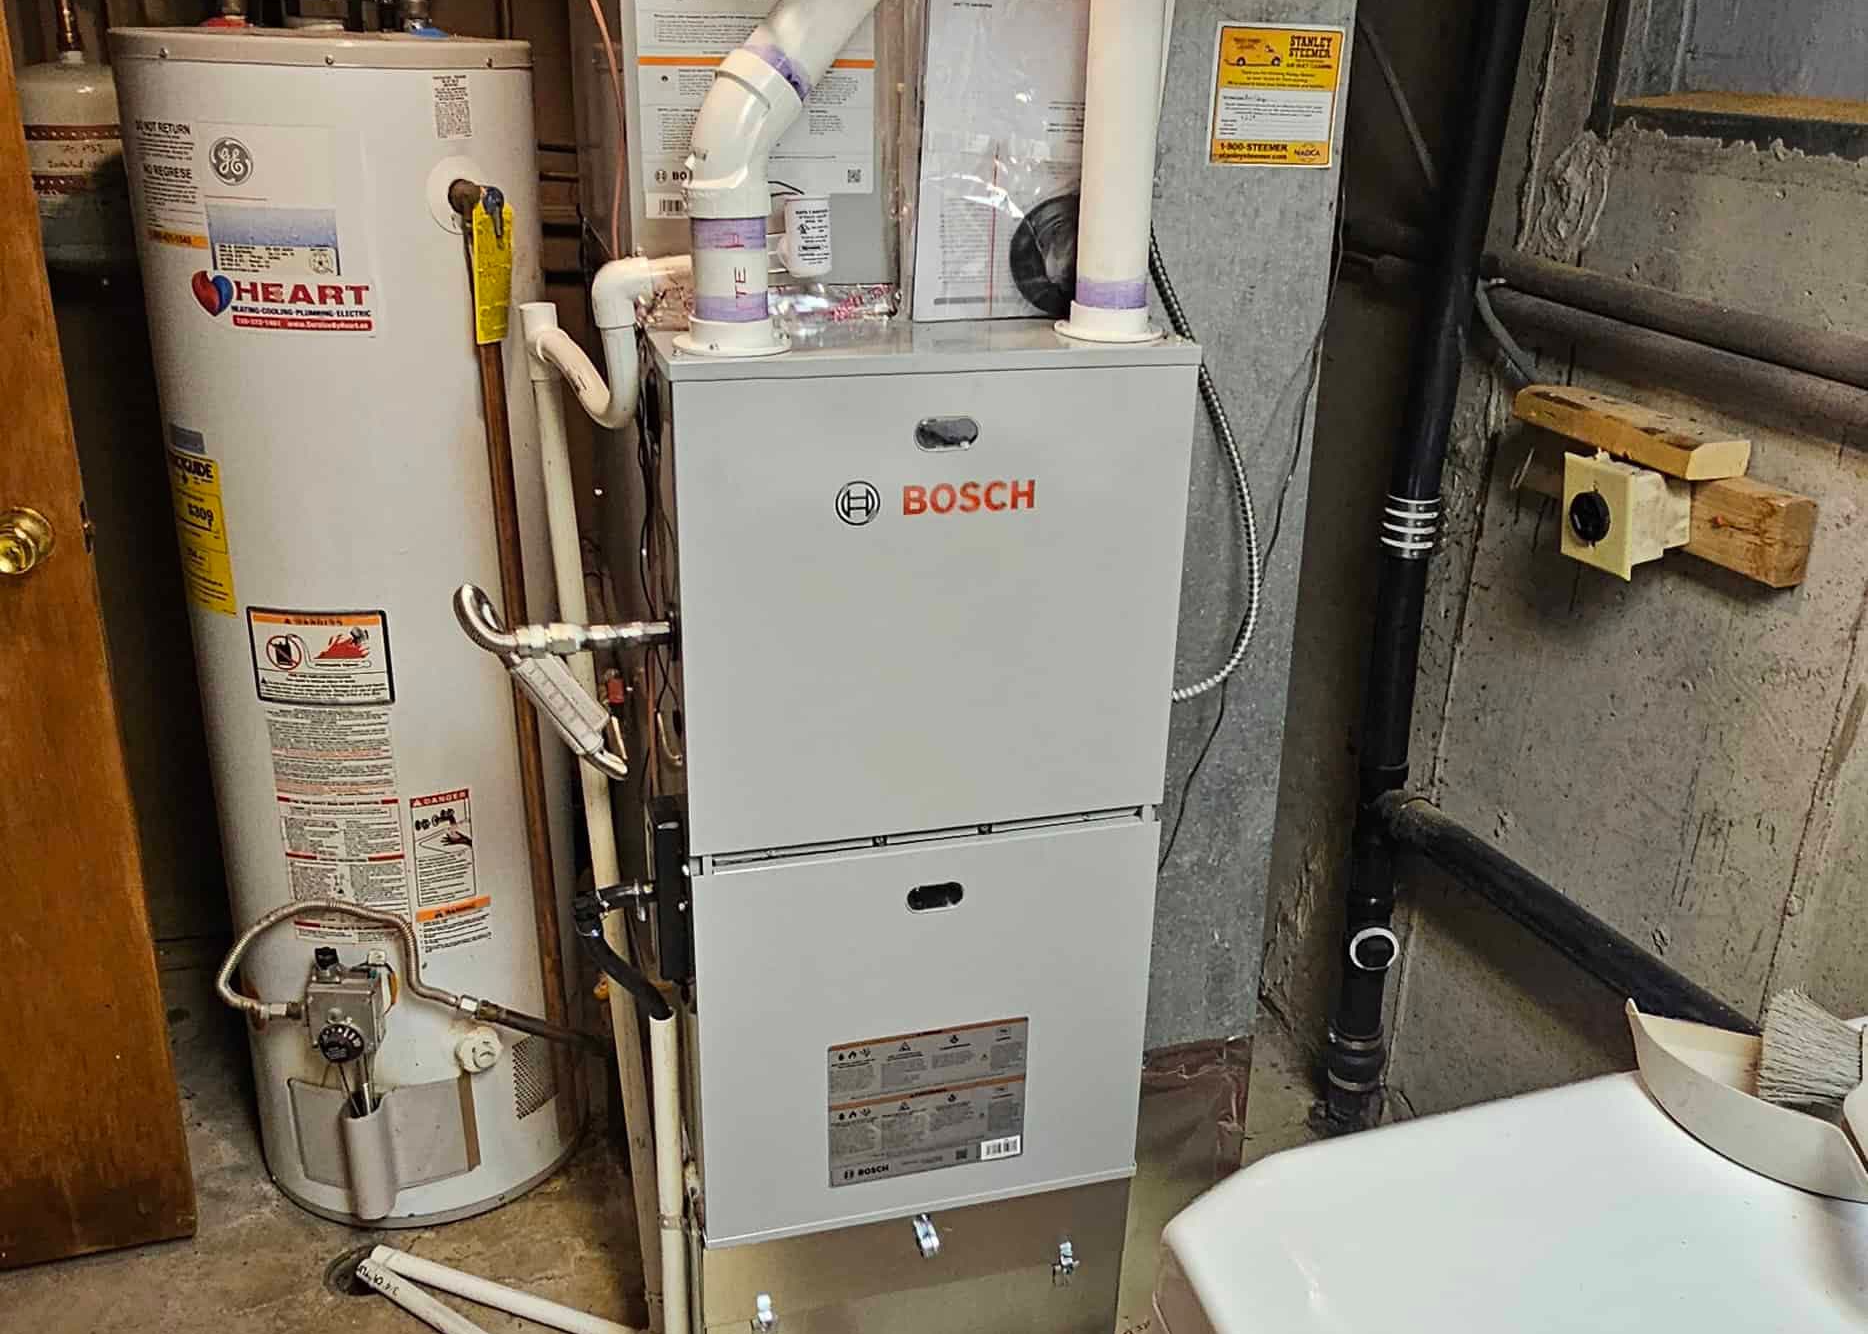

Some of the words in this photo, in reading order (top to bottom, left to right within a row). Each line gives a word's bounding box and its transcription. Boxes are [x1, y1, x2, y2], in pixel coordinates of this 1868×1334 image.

[1290, 35, 1333, 48] STANLEY
[1289, 48, 1331, 58] STEEMER
[157, 122, 191, 134] RETURN
[153, 166, 192, 179] REGRESE
[234, 281, 369, 306] HEART
[903, 479, 1036, 515] BOSCH
[858, 1164, 889, 1177] BOSCH
